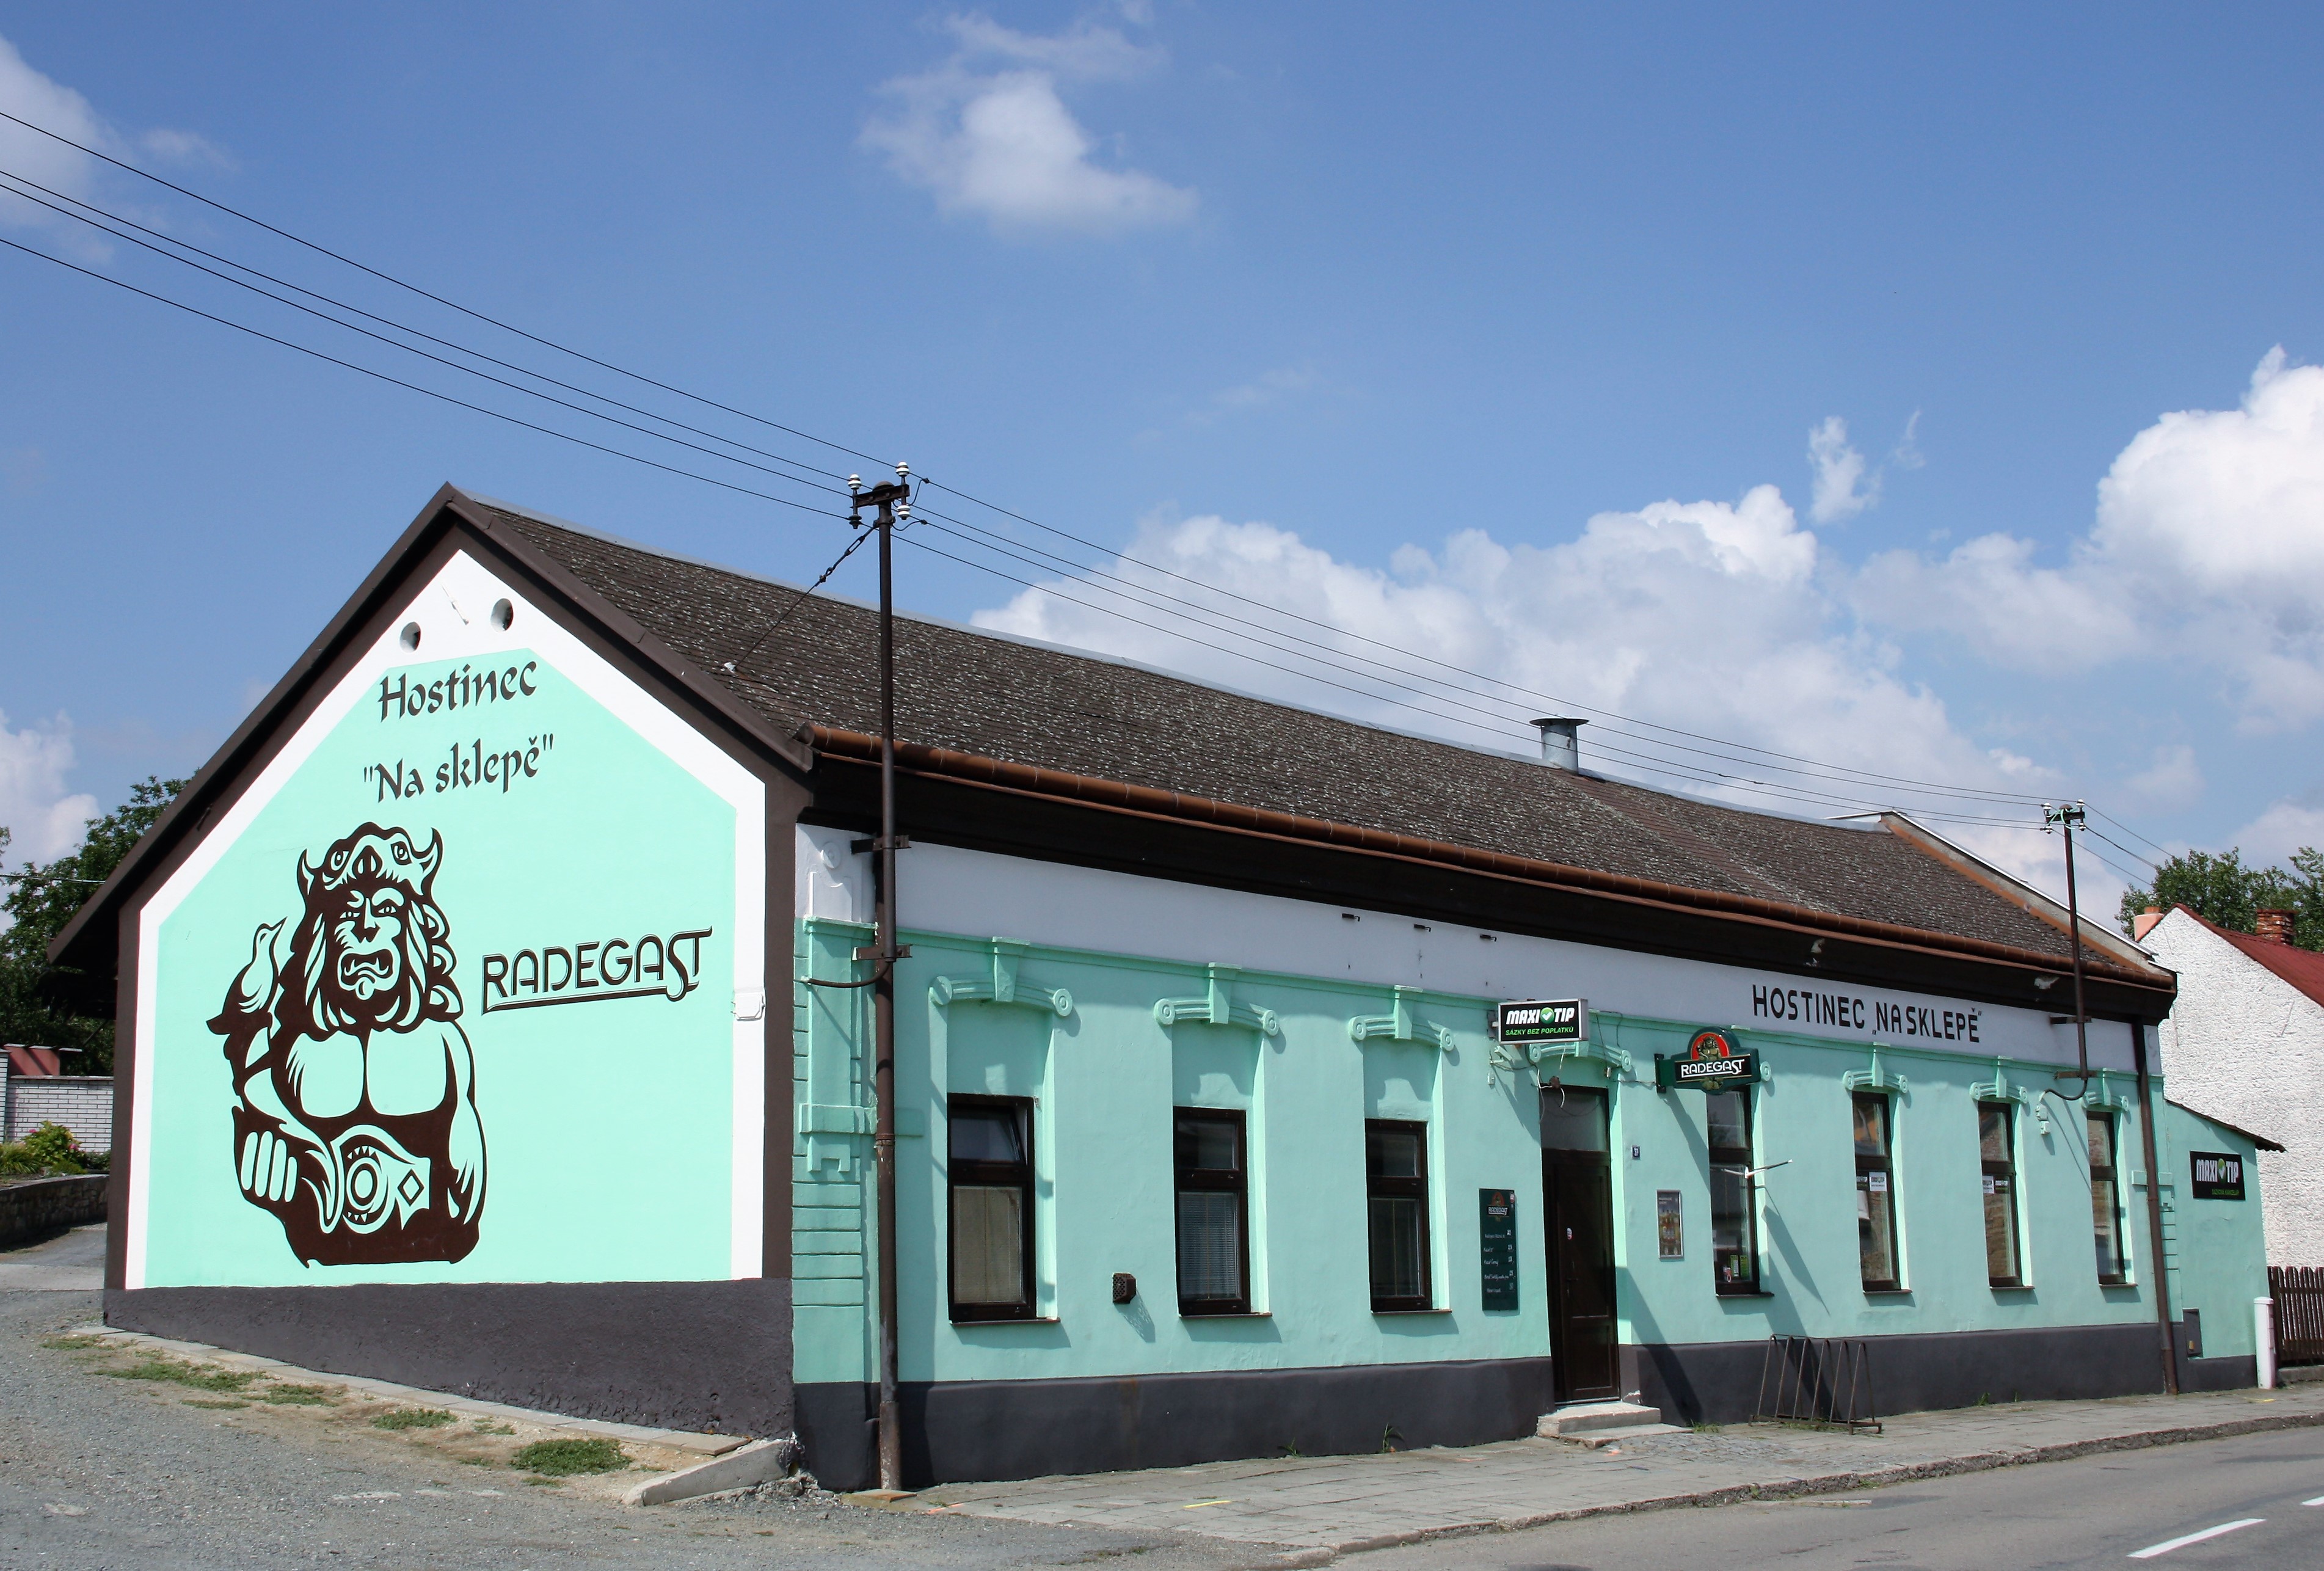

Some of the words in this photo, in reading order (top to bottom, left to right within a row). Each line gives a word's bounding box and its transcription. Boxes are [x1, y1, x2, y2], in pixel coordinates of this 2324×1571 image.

[377, 661, 537, 723] Hostinec
[363, 757, 424, 803] "Na
[435, 732, 553, 794] sklepě"
[481, 925, 713, 1016] RADEGAST
[1506, 1009, 1540, 1025] MAXI
[1554, 1007, 1575, 1022] TIP
[1752, 984, 1865, 1030] HOSTINEC
[1680, 1059, 1745, 1078] RADEGAST
[2196, 1159, 2218, 1183] MAXI
[2225, 1161, 2239, 1184] TIP
